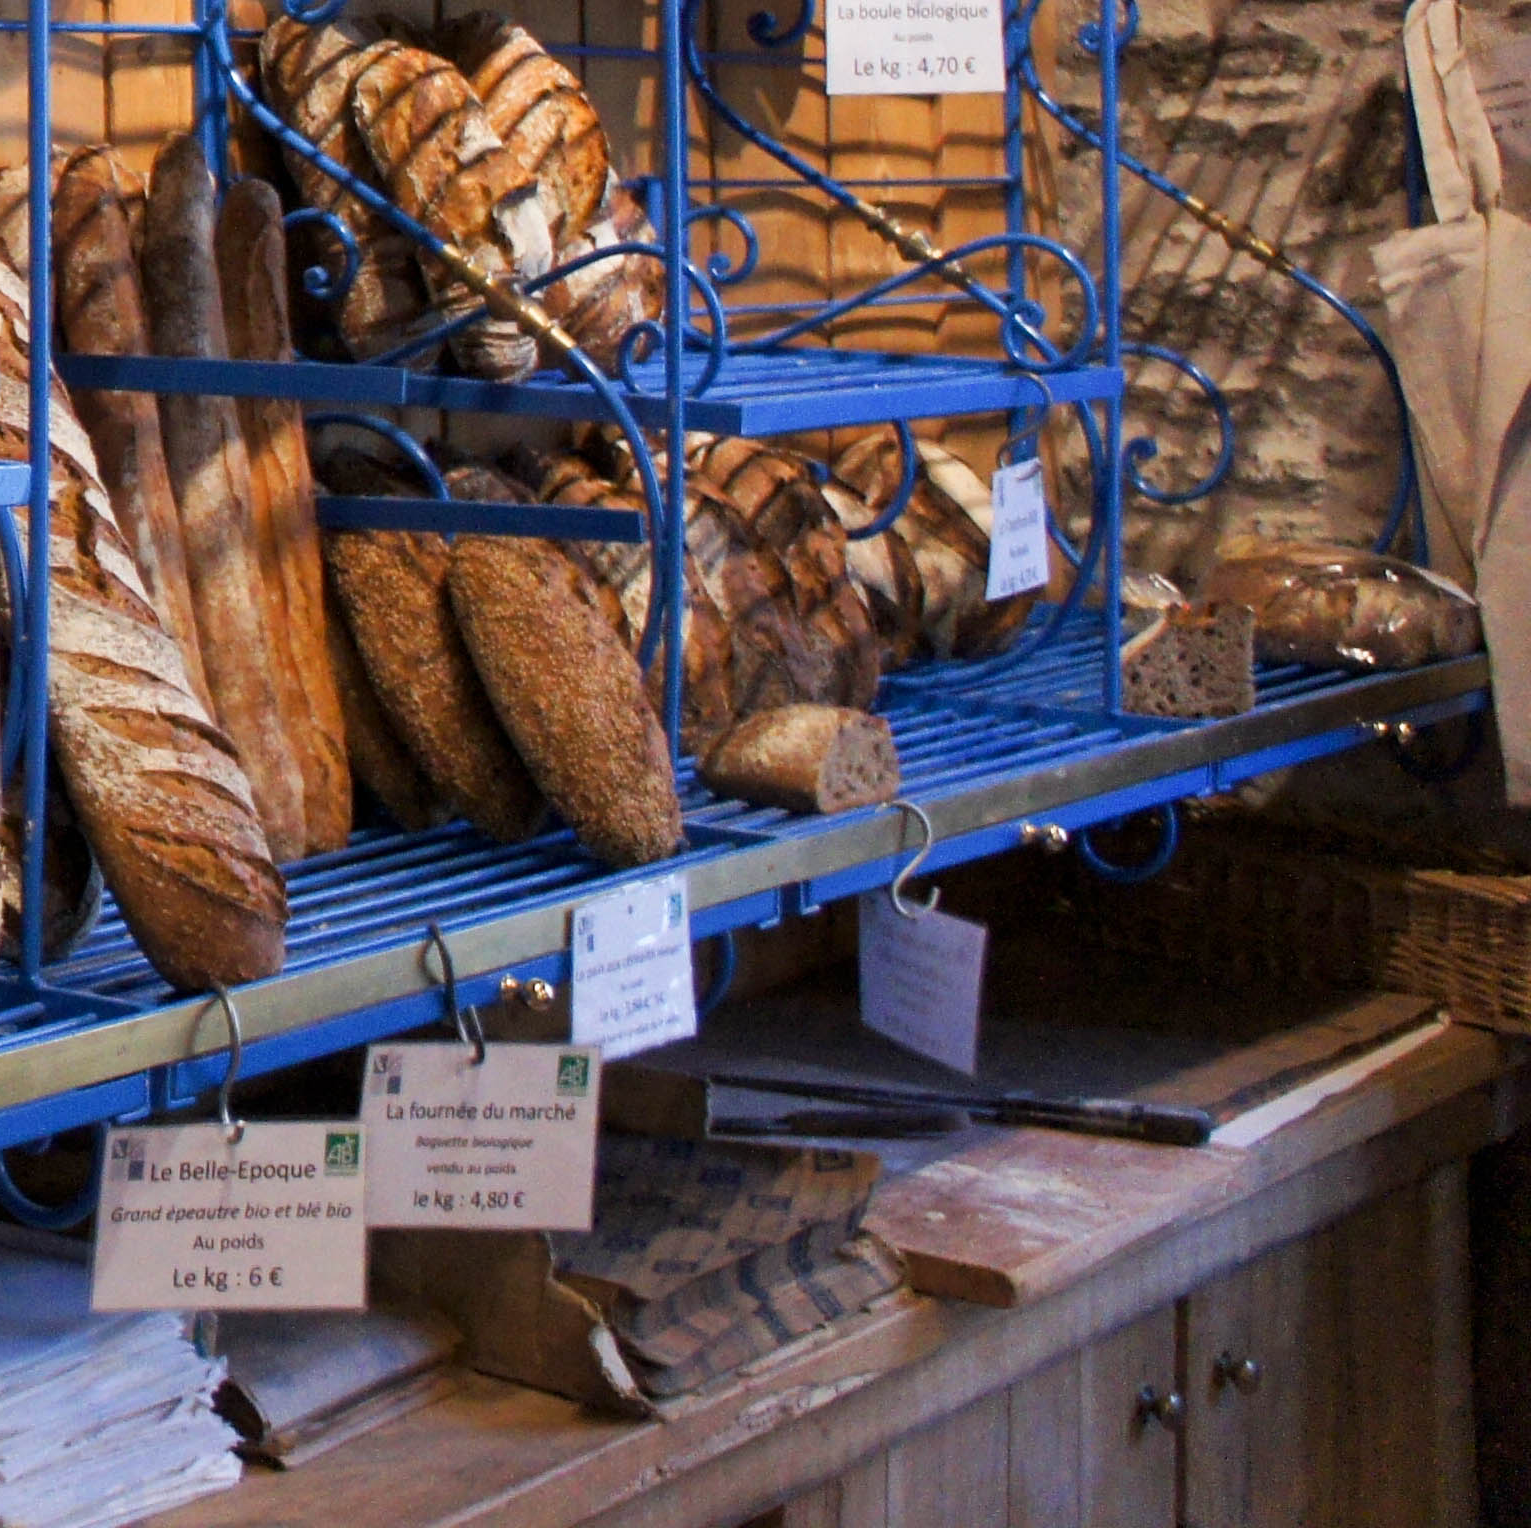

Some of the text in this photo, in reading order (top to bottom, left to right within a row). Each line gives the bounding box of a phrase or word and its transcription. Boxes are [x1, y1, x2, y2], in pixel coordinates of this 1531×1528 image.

[838, 1, 989, 23] La boule biologique
[853, 57, 876, 77] Le
[880, 57, 902, 80] kg
[916, 57, 959, 79] 4,70
[964, 56, 978, 75] €
[386, 1101, 577, 1121] La fournée du marché
[149, 1160, 318, 1184] Le Belle-Epoque
[413, 1190, 430, 1209] le
[434, 1190, 455, 1212] kg
[470, 1190, 510, 1212] 4,80
[513, 1190, 527, 1209] €
[110, 1201, 353, 1224] Grand épeautre bio et blé bio
[192, 1233, 266, 1253] Au poids
[172, 1268, 197, 1289] Le
[203, 1267, 229, 1293] kg
[248, 1267, 263, 1287] 6
[268, 1267, 285, 1287] €
